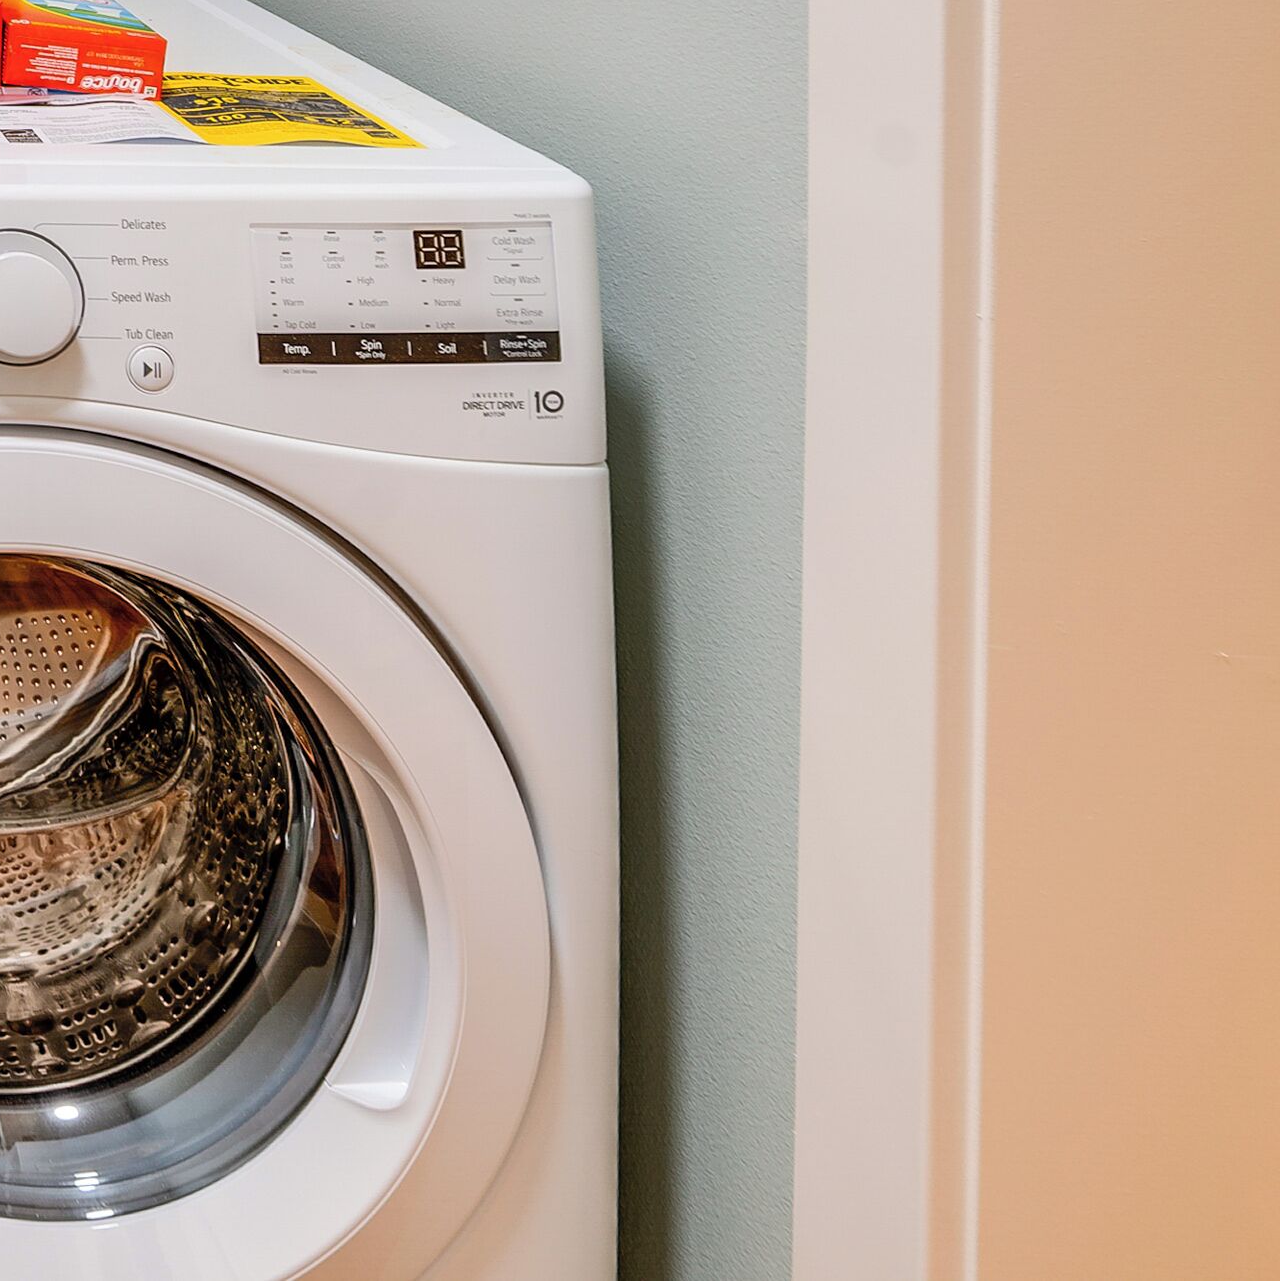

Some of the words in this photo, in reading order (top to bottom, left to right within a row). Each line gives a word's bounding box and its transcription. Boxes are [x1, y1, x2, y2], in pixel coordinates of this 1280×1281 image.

[121, 219, 167, 230] Delicates
[492, 236, 511, 245] Cold
[514, 237, 536, 245] Wash
[111, 256, 139, 267] Perm.
[142, 256, 169, 267] Press
[357, 276, 374, 286] High
[432, 277, 455, 286] Heavy
[494, 275, 516, 286] Delay
[519, 275, 540, 284] Wash
[112, 292, 142, 304] Speed
[145, 293, 171, 303] Wash
[434, 299, 461, 307] Normal
[496, 308, 518, 317] Extra
[521, 309, 543, 317] Rinse
[285, 322, 297, 330] Tap
[300, 321, 316, 329] Cold
[436, 322, 455, 330] Light
[126, 329, 143, 340] Tub
[145, 329, 174, 341] Clean
[283, 343, 311, 356] Temp.
[360, 339, 382, 352] Spin
[438, 343, 457, 354] Soil
[462, 401, 495, 410] DIRECT
[497, 401, 525, 410] DRIVE
[534, 390, 564, 413] 10
